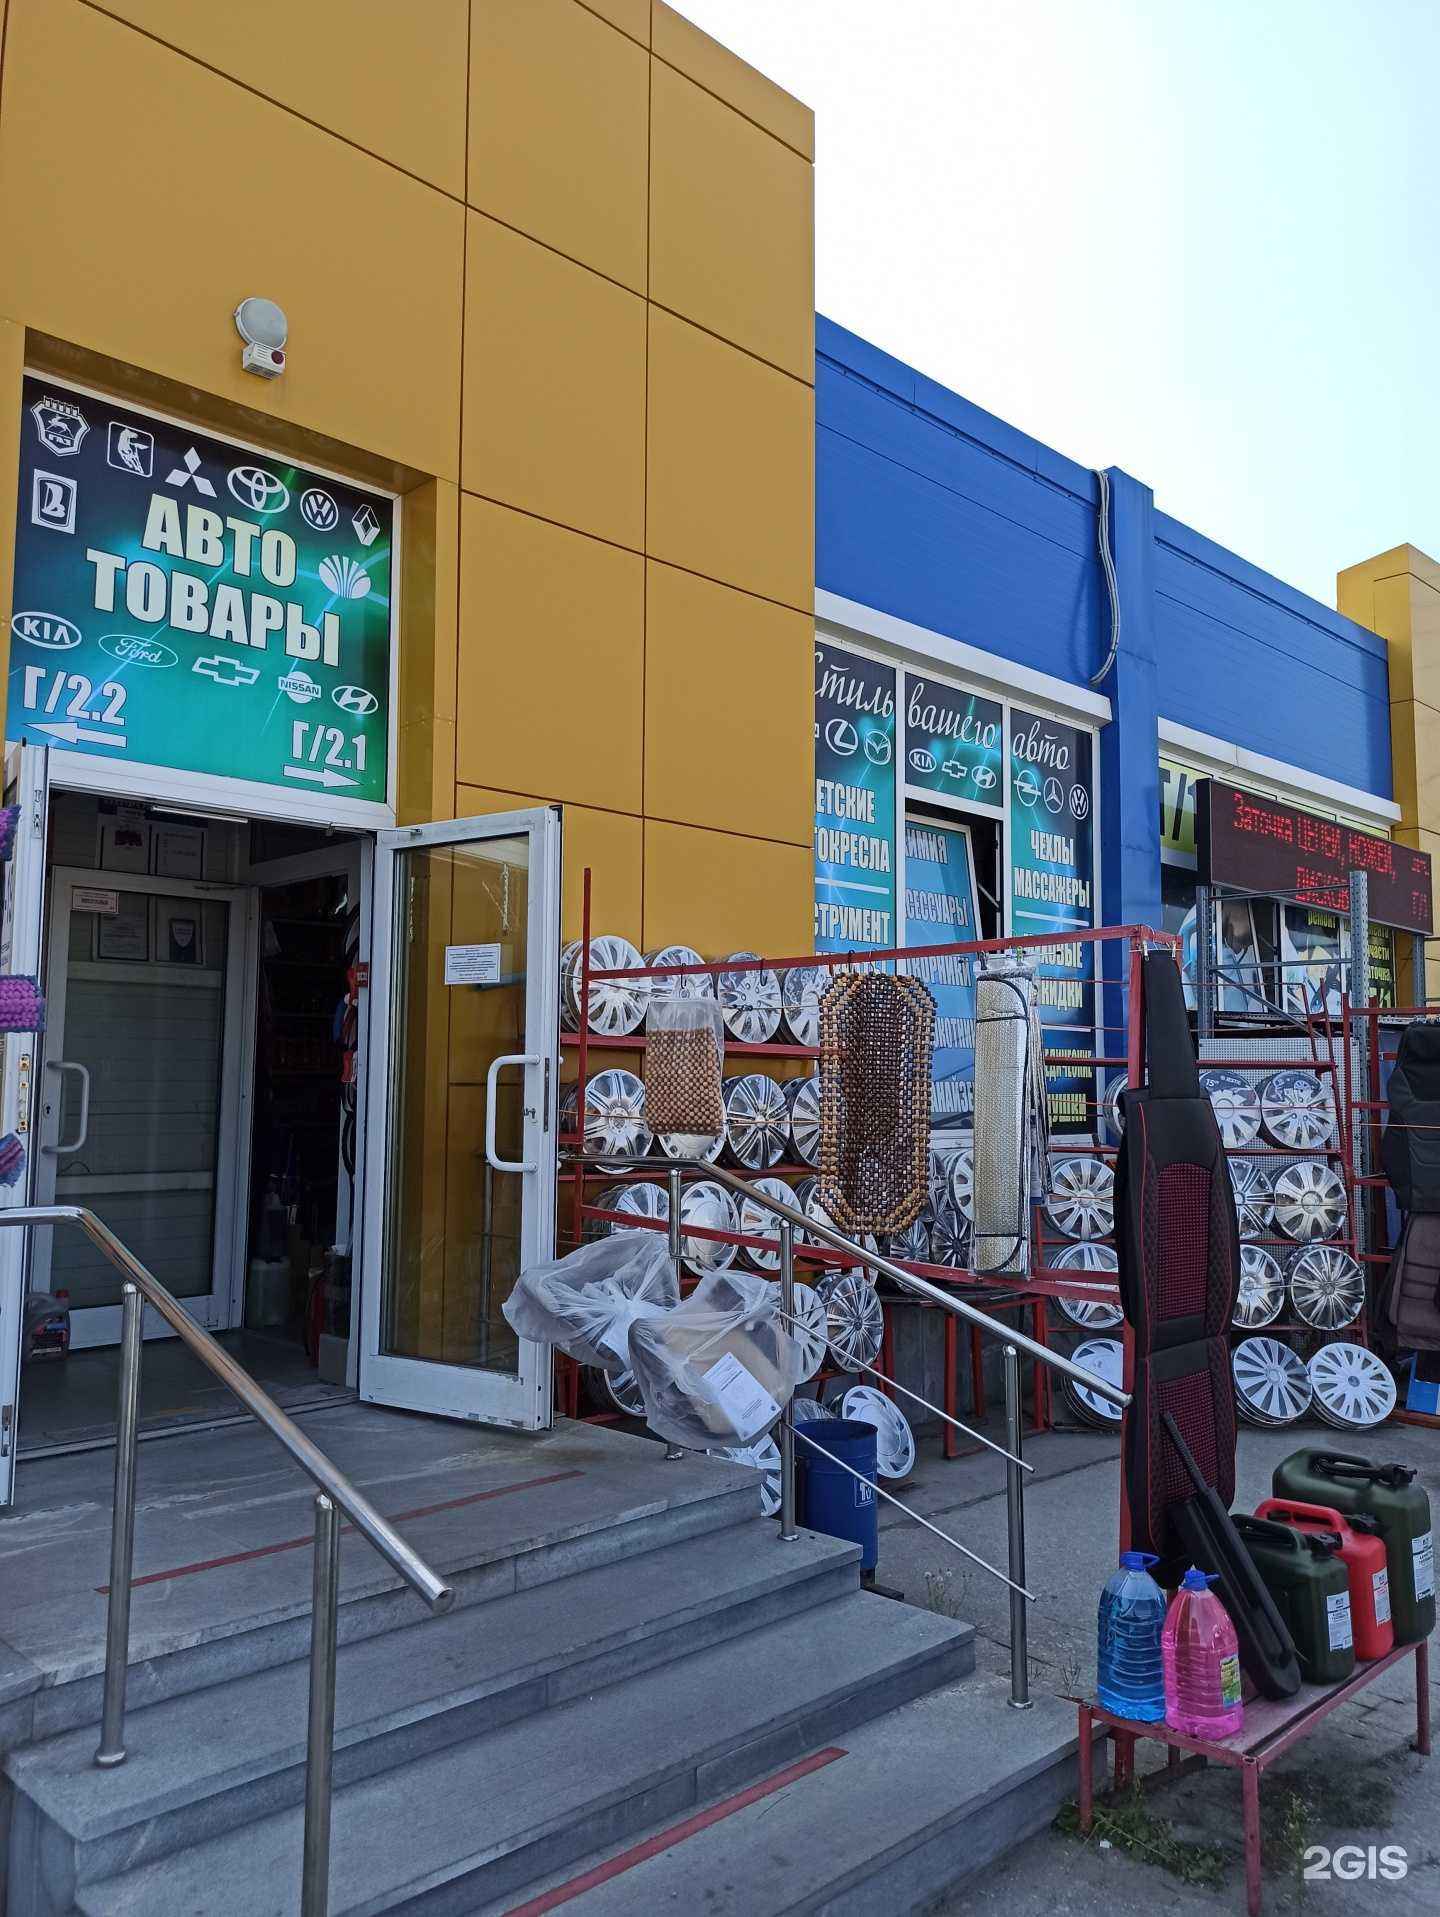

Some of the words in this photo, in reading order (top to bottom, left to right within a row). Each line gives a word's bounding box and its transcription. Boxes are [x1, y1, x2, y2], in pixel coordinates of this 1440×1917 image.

[142, 493, 297, 588] АВТО
[86, 547, 341, 668] ТОВАРЫ
[23, 617, 71, 644] KIA
[115, 637, 162, 664] Ford
[23, 665, 128, 726] Г/2.2
[280, 678, 320, 697] NISSAN
[291, 719, 366, 771] Г/2.1
[907, 682, 998, 749] вашего
[1012, 720, 1071, 770] авто
[815, 778, 876, 824] ЕТСКИЕ
[815, 826, 891, 873] ОКРЕСЛА
[1030, 829, 1075, 866] ЧЕХЛЫ
[905, 888, 969, 927] СЕССУАРЫ
[1014, 866, 1091, 909] МАССАЖЕРЫ
[1040, 977, 1083, 1011] КИДКИ
